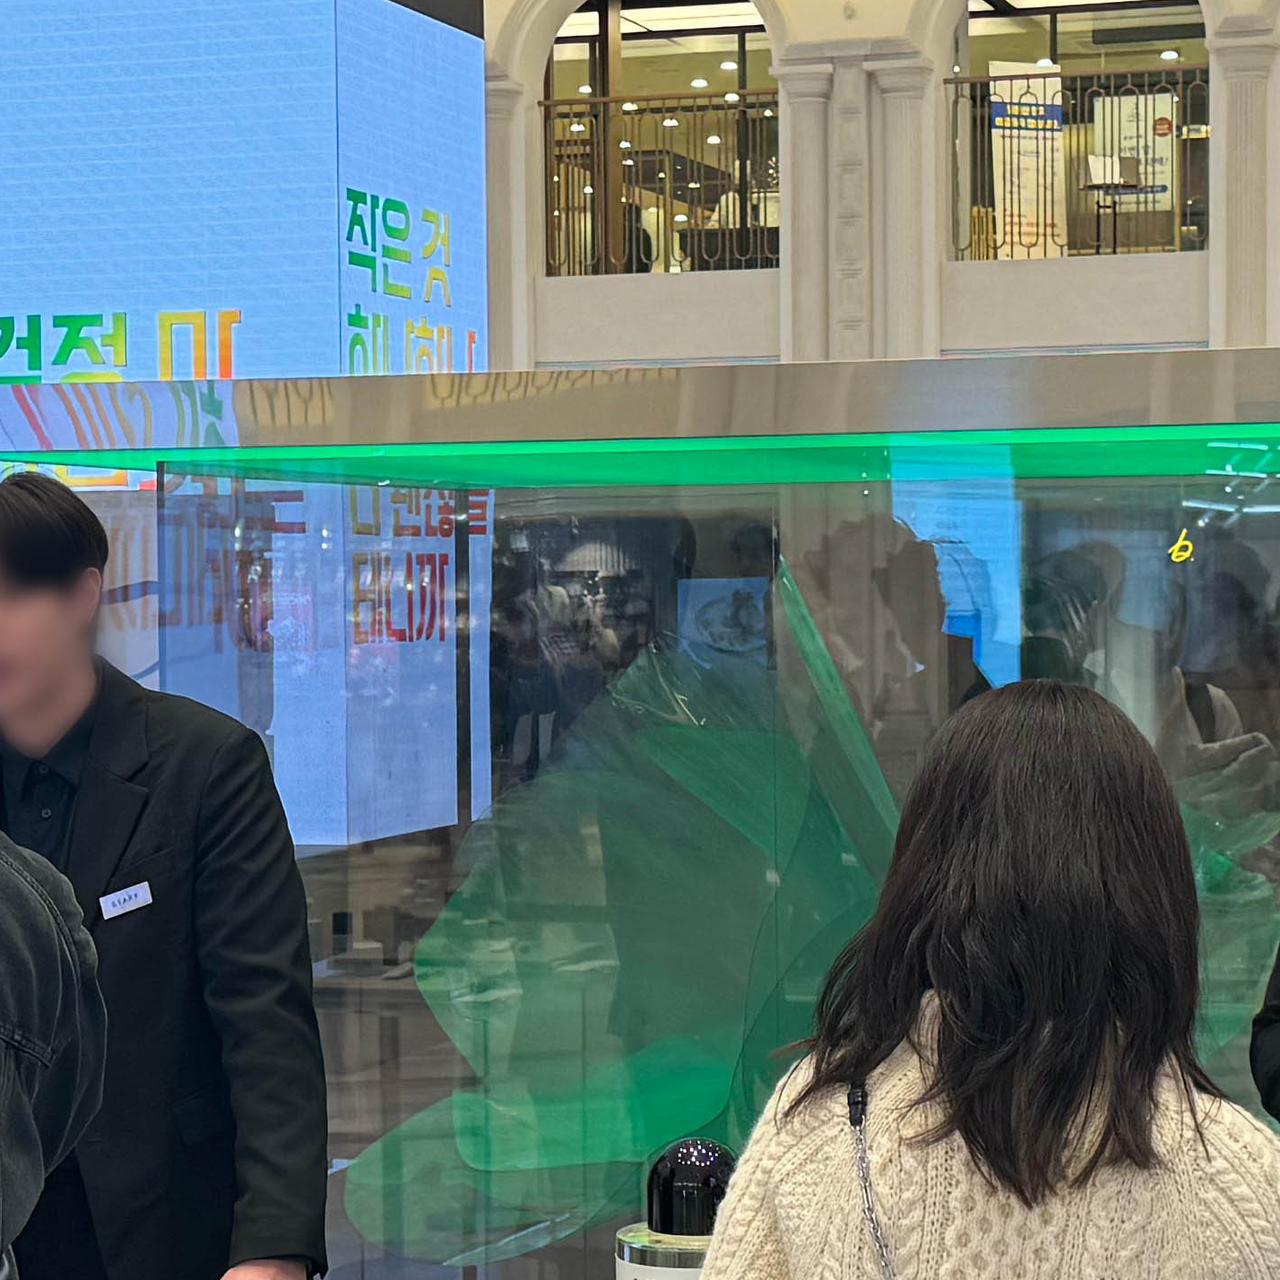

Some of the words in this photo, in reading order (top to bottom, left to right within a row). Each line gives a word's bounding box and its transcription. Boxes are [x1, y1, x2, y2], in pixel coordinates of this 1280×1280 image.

[346, 187, 412, 300] 작은
[421, 208, 452, 308] 것
[351, 551, 449, 646] 테니까
